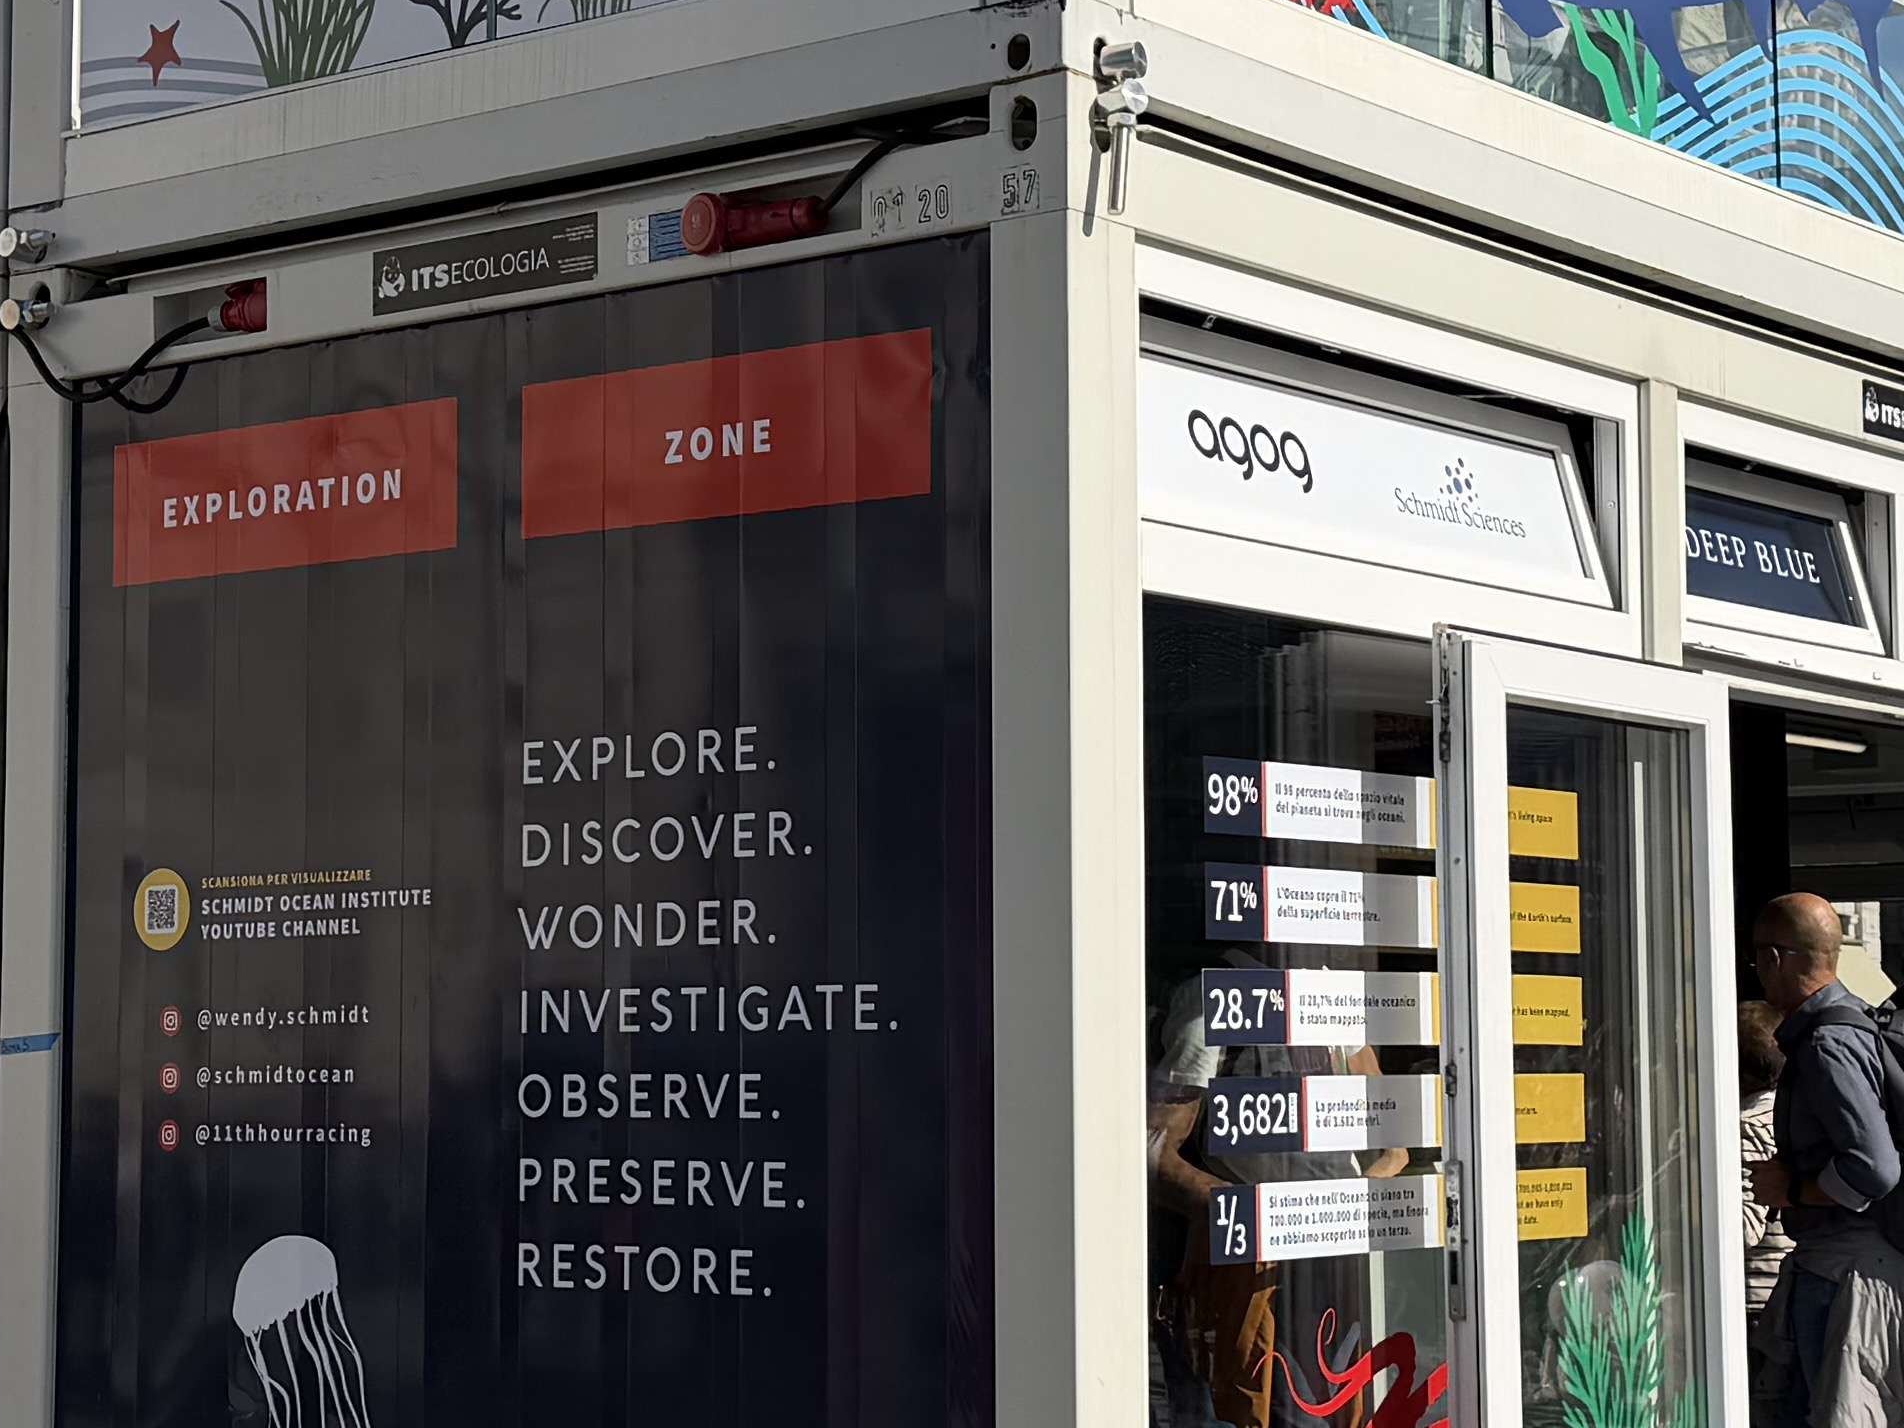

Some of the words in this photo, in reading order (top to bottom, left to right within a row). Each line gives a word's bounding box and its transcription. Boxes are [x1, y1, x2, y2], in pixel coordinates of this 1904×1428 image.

[918, 184, 949, 223] 20
[1002, 168, 1036, 208] 57
[411, 246, 550, 292] ITSECOLOGIA
[162, 467, 404, 529] EXPLORATION
[664, 418, 773, 465] ZONE
[1188, 409, 1314, 494] agog
[1394, 487, 1462, 526] Schmidt
[1462, 499, 1527, 539] Sciences
[1685, 525, 1747, 569] DEEP
[1754, 540, 1821, 584] BLUE
[522, 725, 776, 785] EXPLORE.
[1207, 774, 1259, 817] 98%
[521, 810, 813, 868] DISCOVER.
[201, 875, 264, 889] SCANSIONA
[266, 873, 288, 886] PER
[291, 869, 371, 885] VISUALIZZARE
[201, 895, 274, 916] SCHMIDT
[280, 891, 335, 912] OCEAN
[341, 888, 432, 909] INSTITUTE
[1210, 880, 1257, 922] 71%
[201, 921, 276, 940] YOUTUBE
[282, 918, 361, 938] CHANNEL
[518, 899, 777, 951] WONDER.
[197, 1005, 370, 1030] @wendy.schmidt
[521, 984, 899, 1034] INVESTIGATE.
[1209, 988, 1285, 1031] 28.7%
[196, 1065, 355, 1088] @schmidtocean
[518, 1073, 780, 1120] OBSERVE.
[195, 1123, 372, 1147] @11thhourracing
[1213, 1093, 1288, 1145] 3,682
[518, 1158, 806, 1209] PRESERVE.
[517, 1242, 772, 1298] RESTORE.
